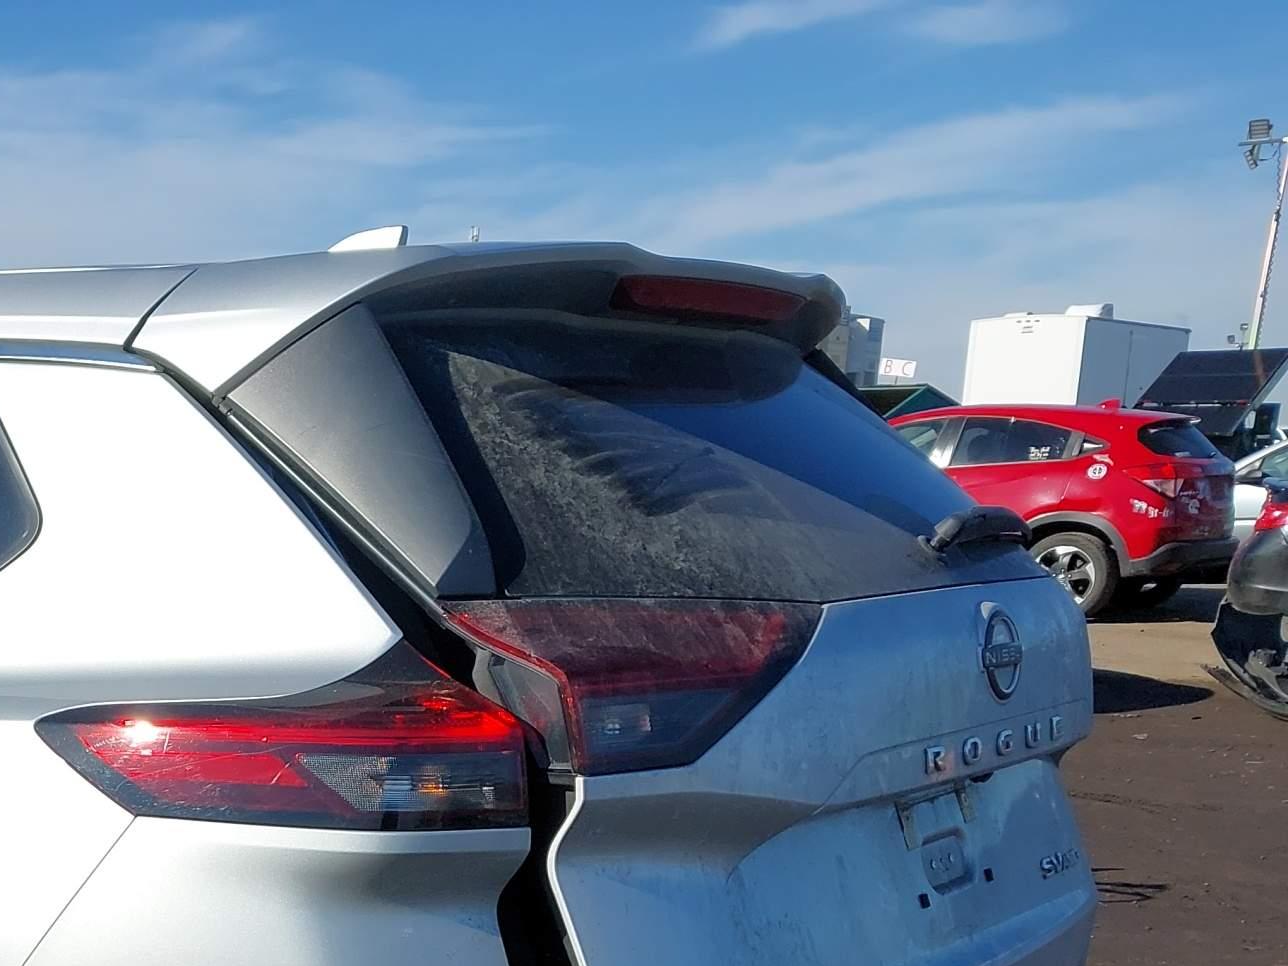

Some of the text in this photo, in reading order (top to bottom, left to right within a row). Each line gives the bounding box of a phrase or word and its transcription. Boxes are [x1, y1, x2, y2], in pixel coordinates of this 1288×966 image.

[883, 359, 914, 377] B C
[924, 714, 1064, 775] ROGUE
